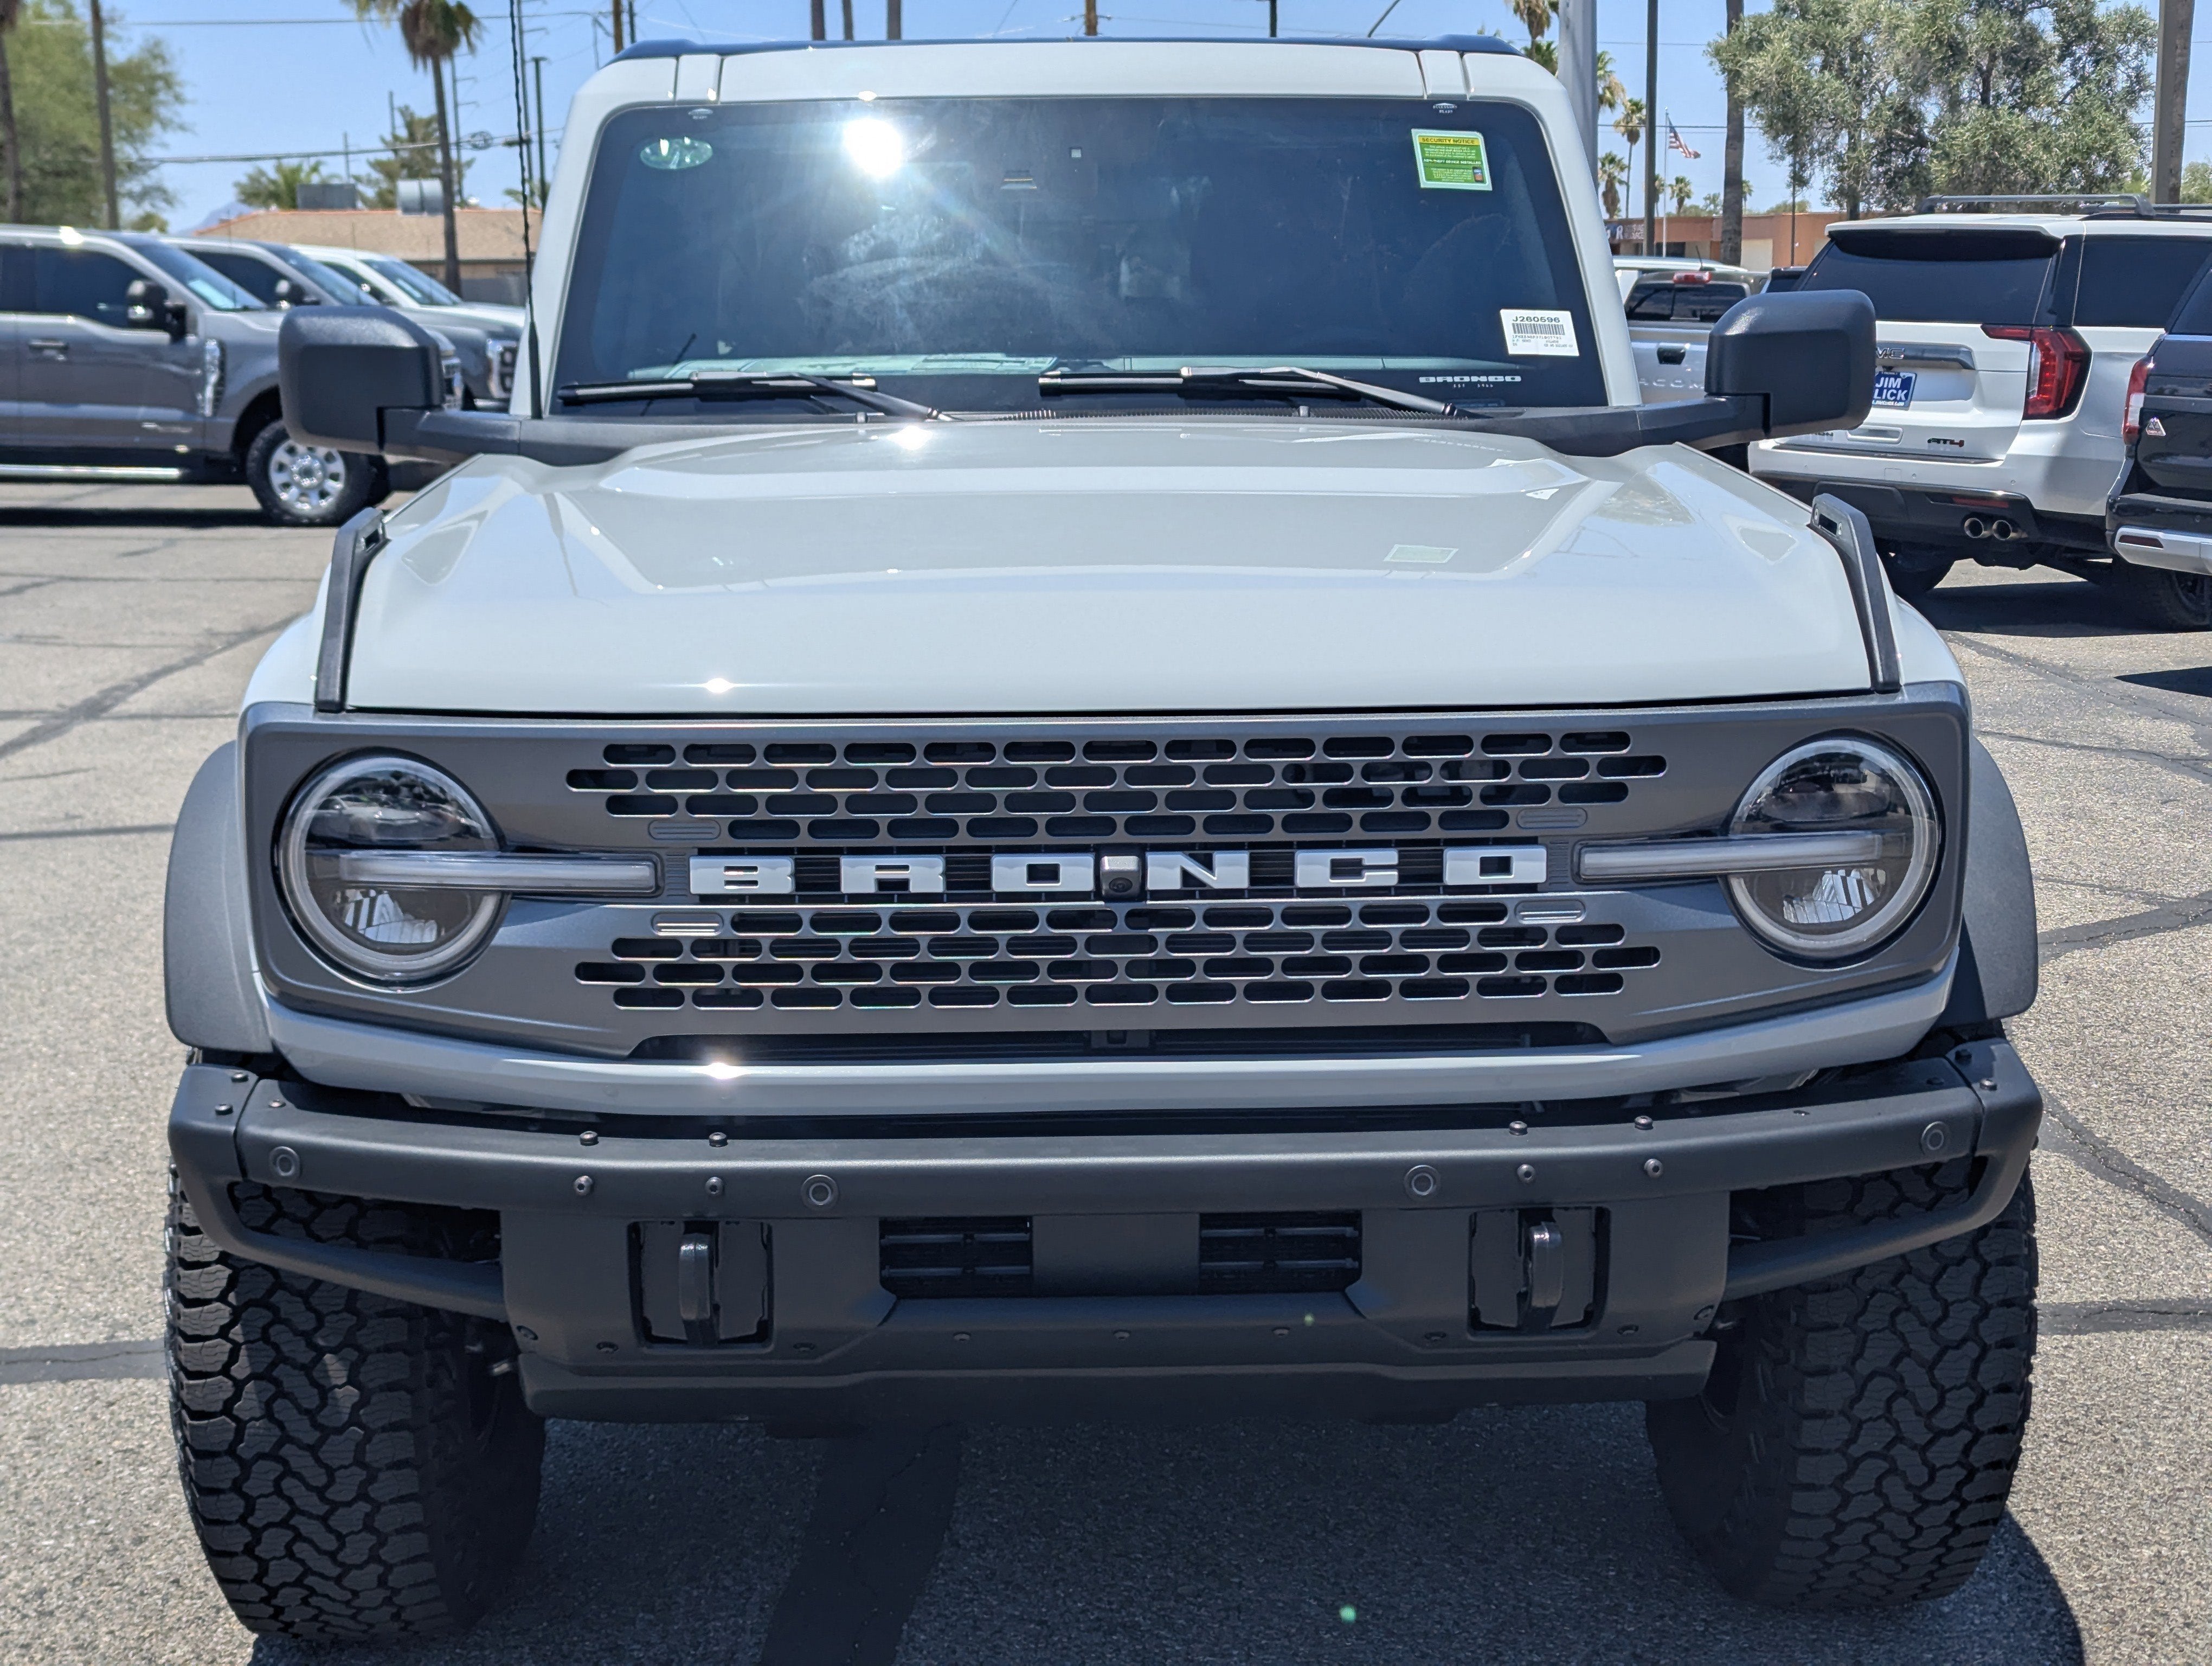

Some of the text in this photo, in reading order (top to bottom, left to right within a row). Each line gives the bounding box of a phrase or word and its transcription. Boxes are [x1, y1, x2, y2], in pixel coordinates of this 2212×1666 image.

[1876, 347, 1905, 360] MC
[1419, 375, 1522, 383] BRONCO
[1875, 377, 1902, 388] JIM
[1873, 388, 1908, 401] LICK
[1927, 438, 1965, 447] AT4
[689, 845, 1547, 895] BRONCO
